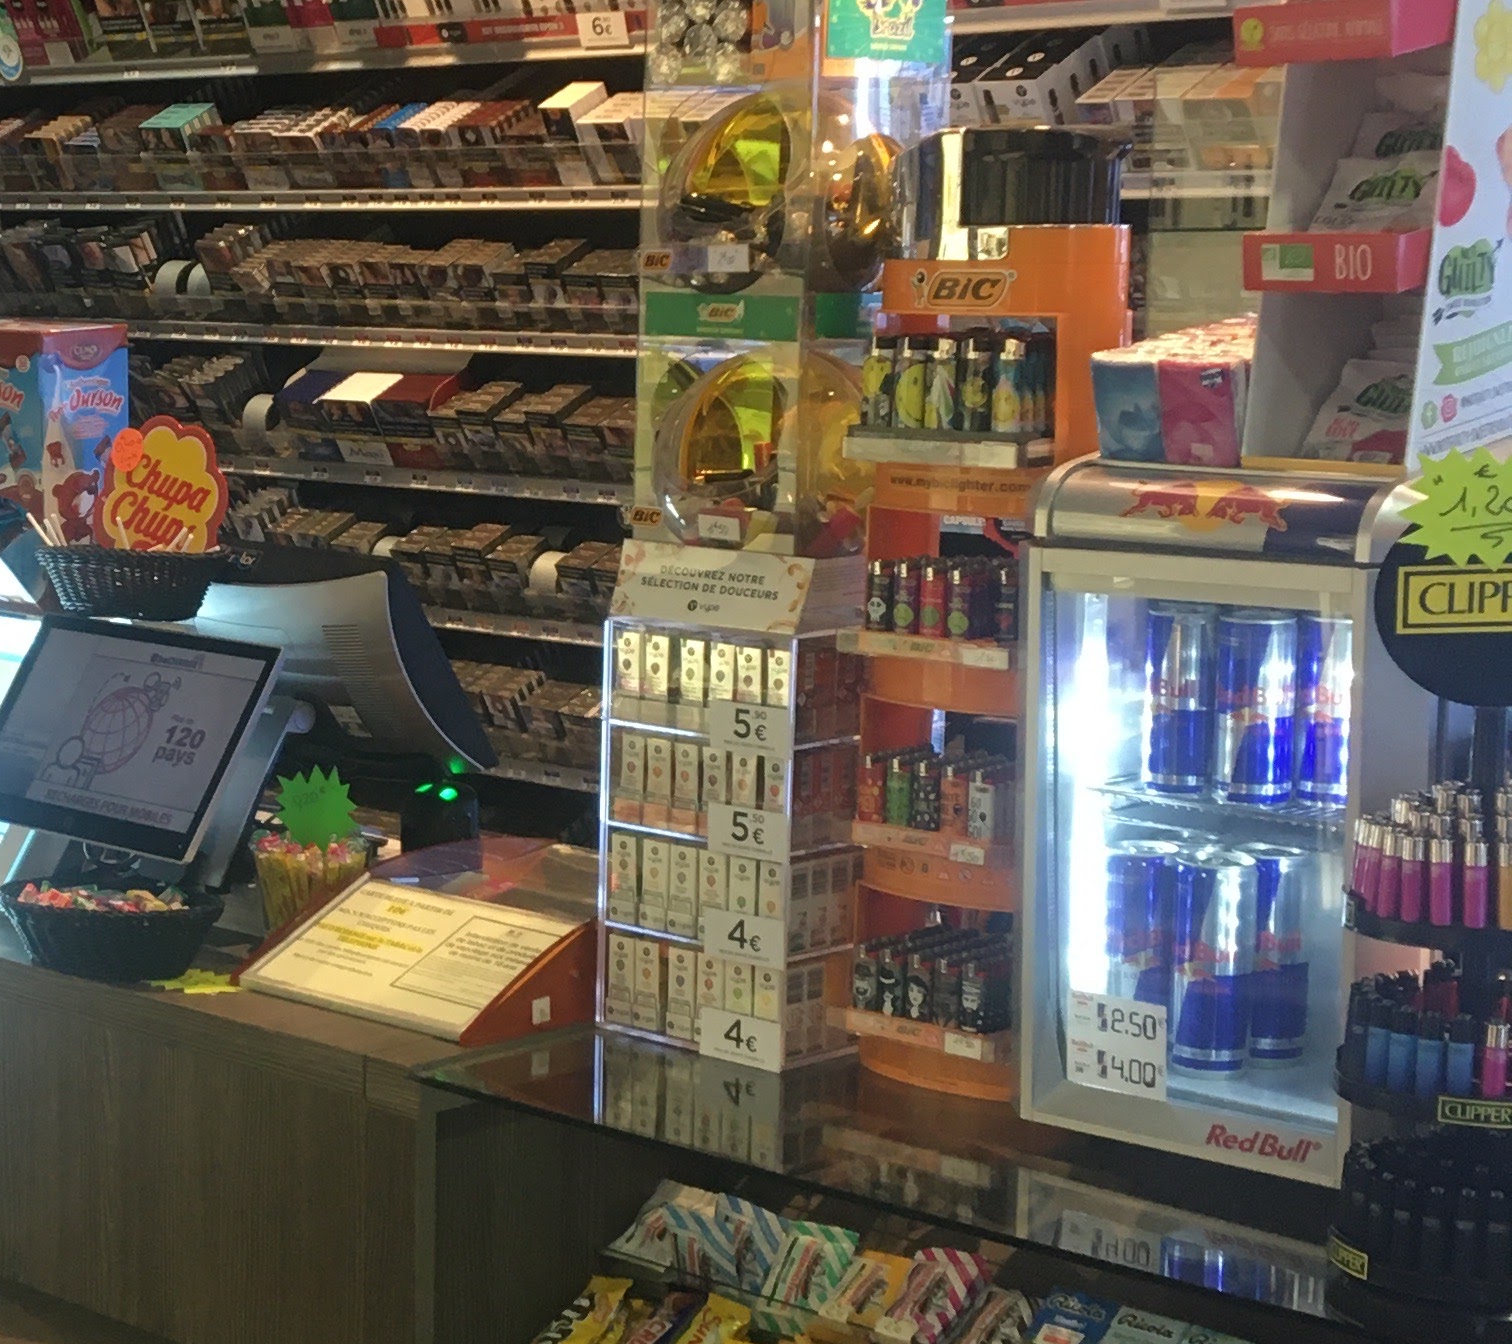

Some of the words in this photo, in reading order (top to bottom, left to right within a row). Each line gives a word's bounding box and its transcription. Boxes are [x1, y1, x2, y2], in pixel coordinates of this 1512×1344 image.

[1334, 243, 1373, 280] BIO
[1439, 252, 1494, 296] GUILTY
[69, 388, 124, 413] Ourson
[125, 452, 212, 513] Chupa
[890, 475, 1032, 493] www.mybiclighter.com
[640, 574, 699, 593] SÉLECTION
[702, 583, 716, 594] DE
[719, 586, 779, 601] DOUCEURS
[660, 562, 726, 581] DÉCOUVREZ
[728, 572, 765, 586] NOTRE
[698, 602, 720, 612] vype
[165, 725, 207, 750] 120
[152, 745, 197, 767] pays
[46, 788, 102, 809] RECHARGES
[104, 797, 128, 814] POUR
[131, 805, 174, 826] MOBILES
[1110, 1007, 1158, 1040] 2.50
[1110, 1055, 1157, 1088] 4.00
[1046, 1293, 1107, 1321] Ricola
[1117, 1313, 1174, 1339] Ricola
